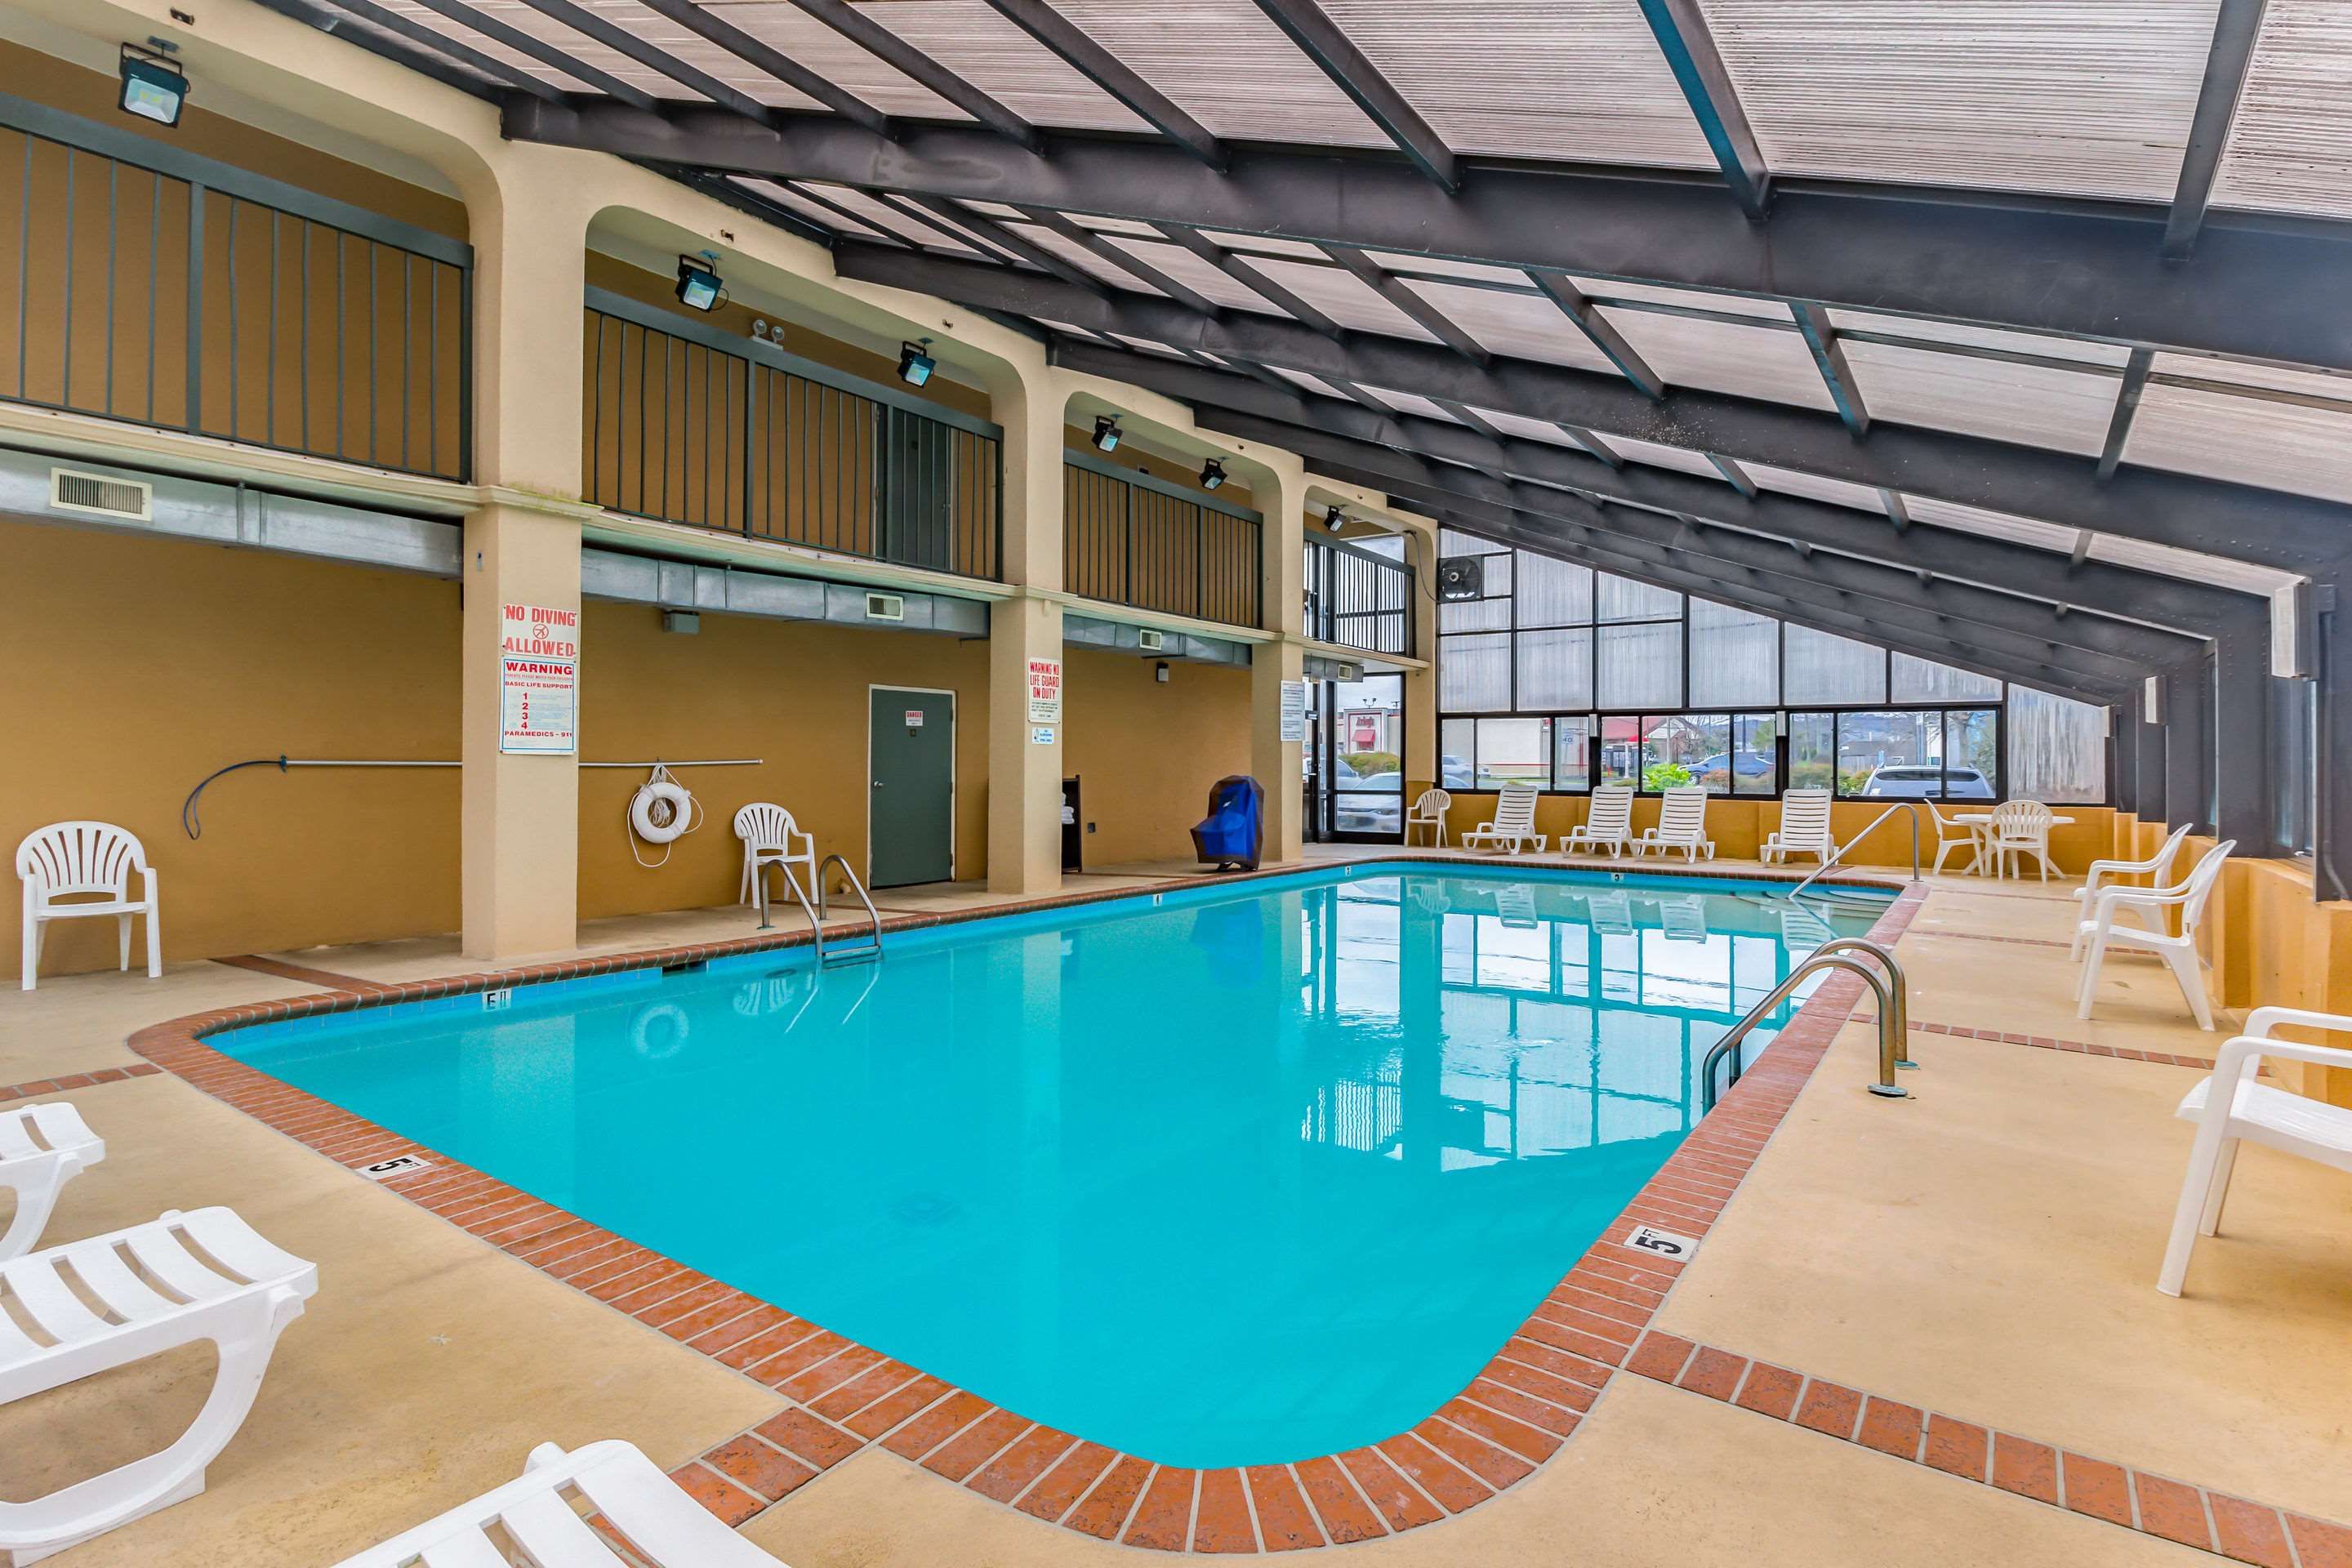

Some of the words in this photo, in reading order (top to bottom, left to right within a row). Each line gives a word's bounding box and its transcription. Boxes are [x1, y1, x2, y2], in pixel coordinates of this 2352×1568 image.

[506, 604, 525, 620] NO
[532, 608, 576, 626] DIVING
[504, 637, 575, 657] ALLOWED
[506, 662, 572, 675] WARNING
[1030, 662, 1052, 675] WARNING
[1054, 664, 1059, 675] NO
[1030, 674, 1040, 686] LIFE
[1042, 675, 1059, 688] GUARD
[1033, 687, 1040, 698] ON
[1042, 688, 1056, 700] DUTY
[368, 1158, 412, 1172] 5
[1642, 1228, 1660, 1239] FT
[1634, 1236, 1682, 1254] 5
